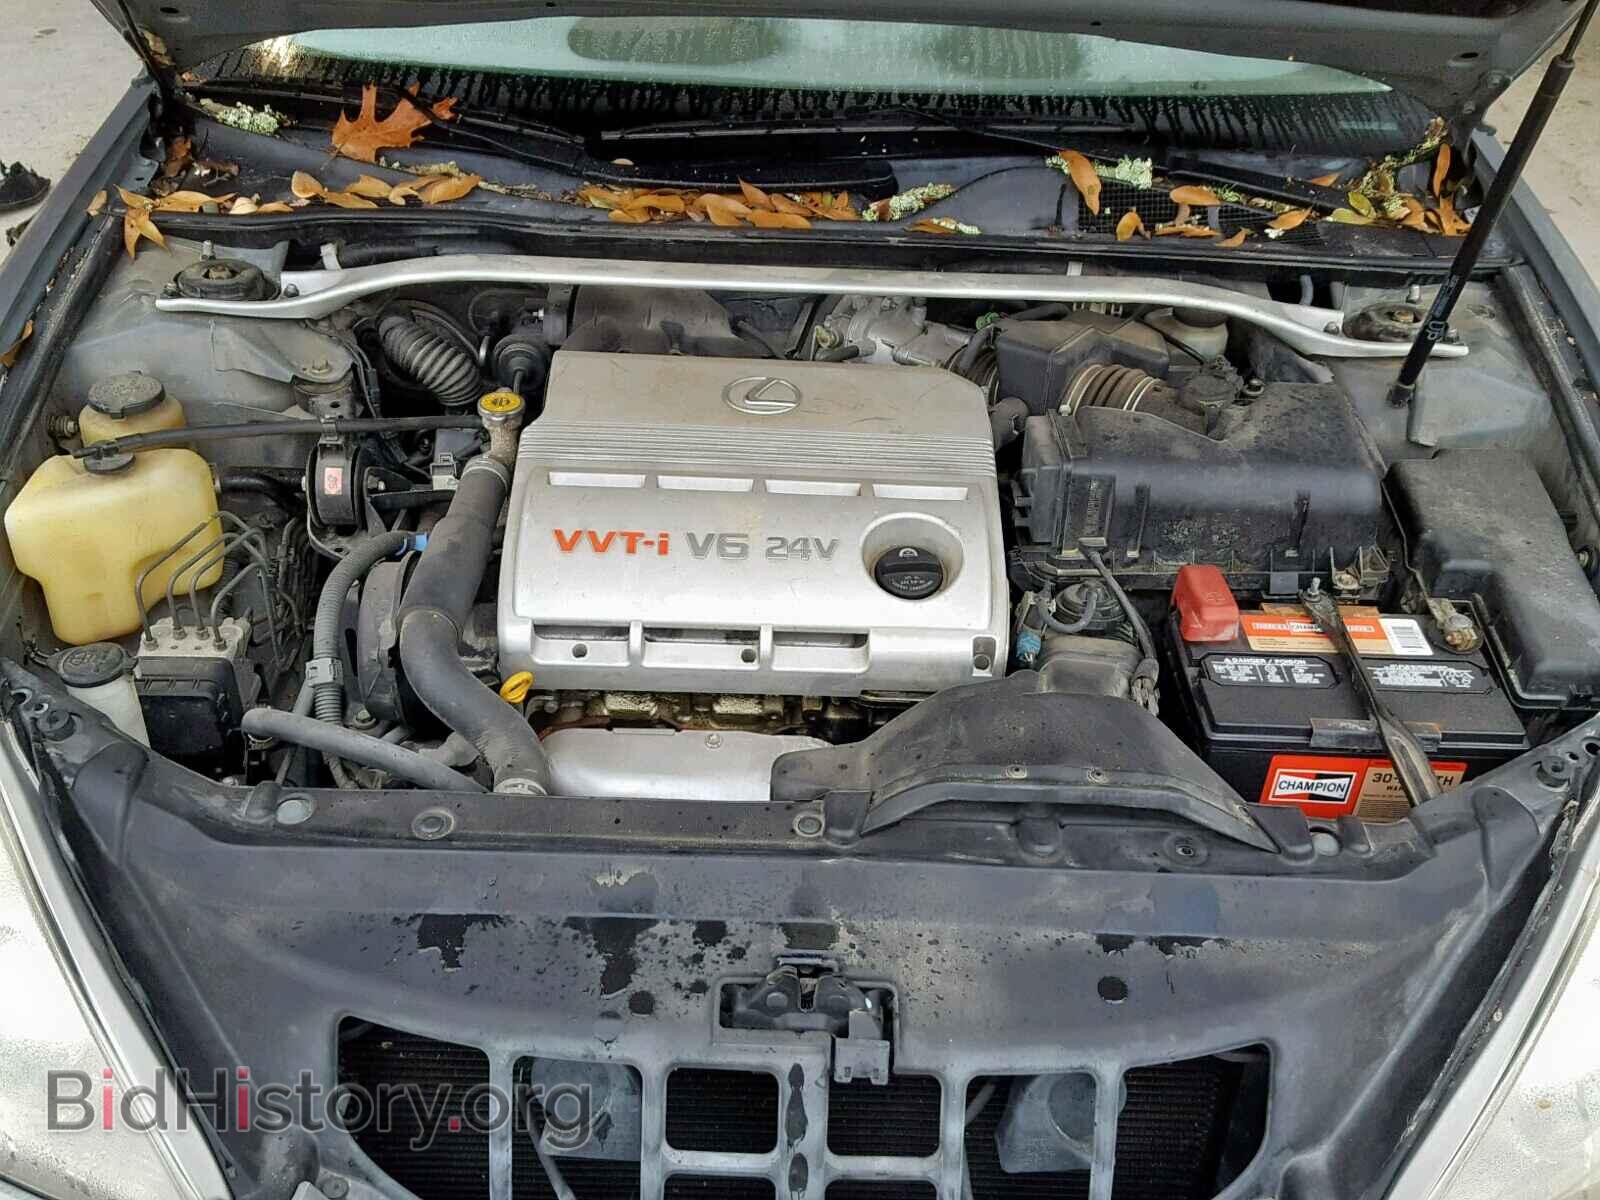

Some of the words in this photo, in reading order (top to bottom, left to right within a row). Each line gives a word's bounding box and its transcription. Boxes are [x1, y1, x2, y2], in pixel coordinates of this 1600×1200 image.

[553, 529, 670, 555] VVT-i
[686, 532, 749, 560] V6
[765, 536, 839, 560] 24V
[1278, 779, 1347, 794] CHAMPION
